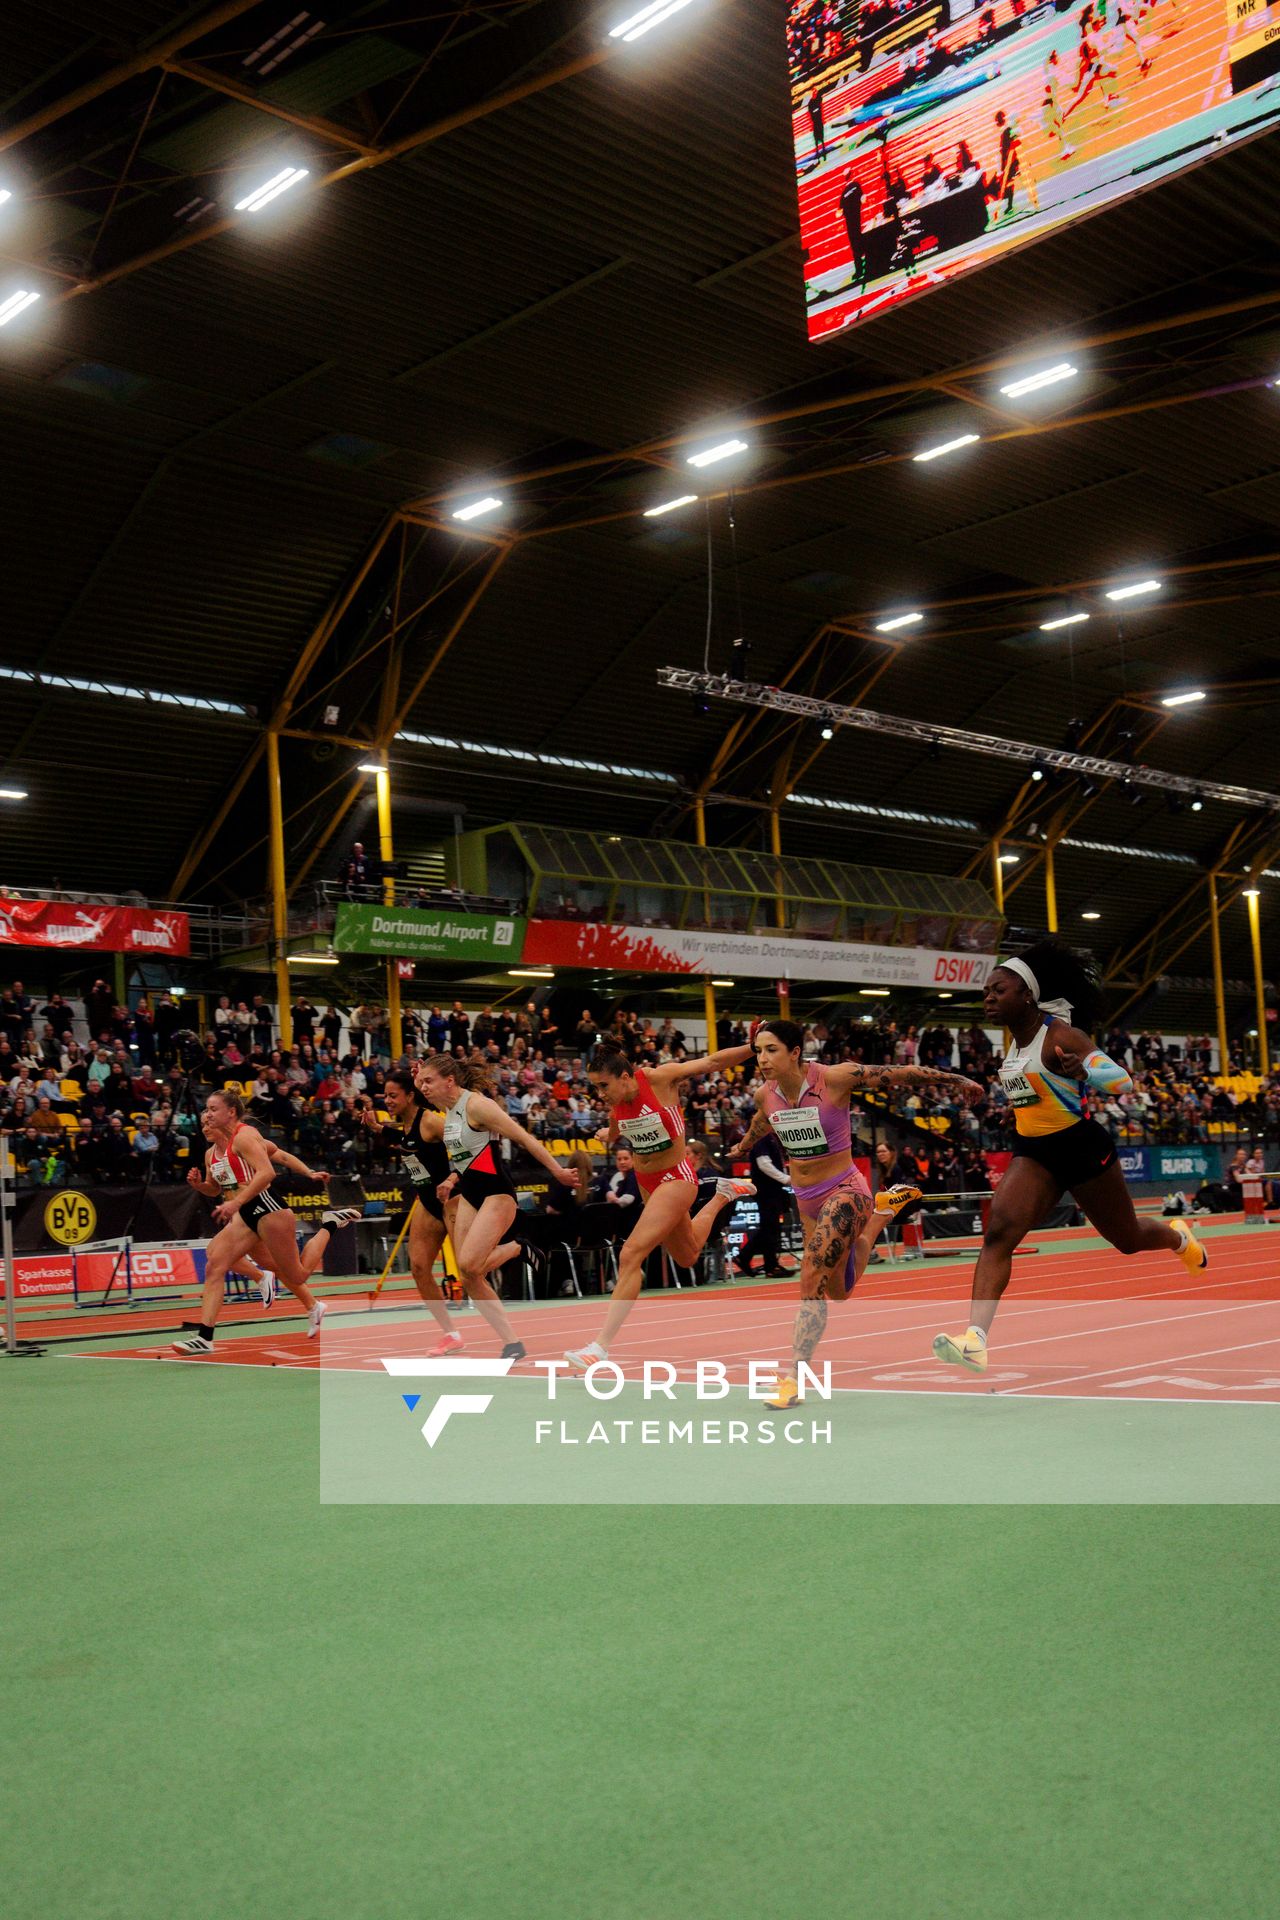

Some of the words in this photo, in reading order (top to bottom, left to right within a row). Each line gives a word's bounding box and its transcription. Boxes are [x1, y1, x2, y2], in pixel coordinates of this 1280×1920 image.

[371, 917, 441, 936] Dortmund
[441, 922, 488, 943] Airport
[682, 938, 701, 951] Wir
[703, 940, 758, 956] verbinden
[761, 943, 819, 959] Dortmunds
[821, 948, 870, 963] packende
[871, 951, 916, 966] Momente
[1161, 1157, 1194, 1175] RUHR
[53, 1197, 90, 1229] BVB
[64, 1228, 78, 1239] 09
[17, 1267, 72, 1282] Sparkasse
[112, 1253, 173, 1276] LGO
[20, 1280, 74, 1294] Dortmund
